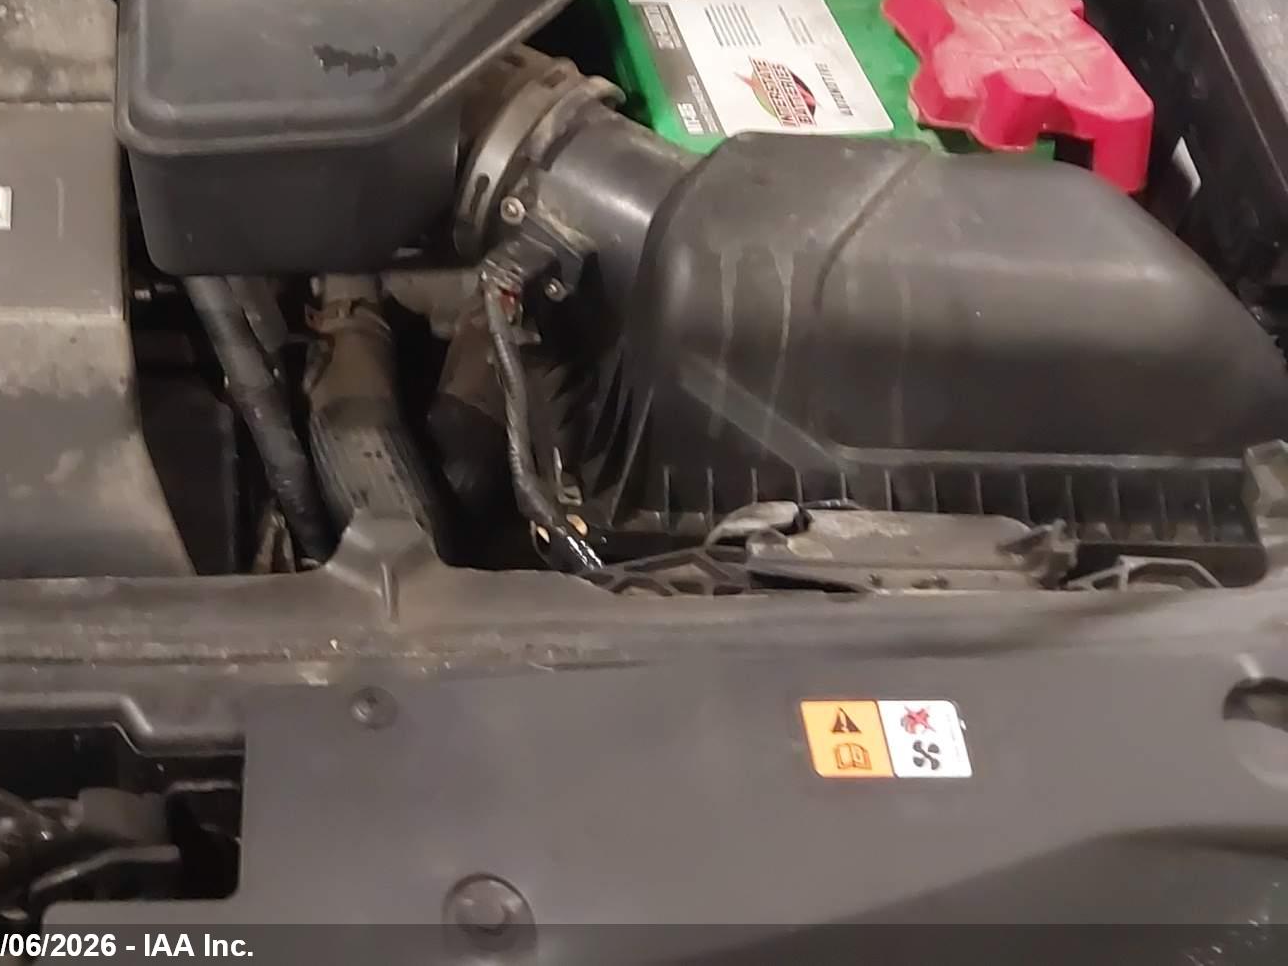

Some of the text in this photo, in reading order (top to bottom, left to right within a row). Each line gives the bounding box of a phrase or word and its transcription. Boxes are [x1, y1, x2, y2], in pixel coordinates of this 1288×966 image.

[752, 58, 798, 127] INTERSTATE
[771, 63, 813, 125] BATTERIES
[814, 62, 853, 116] AUTOMOTIVE
